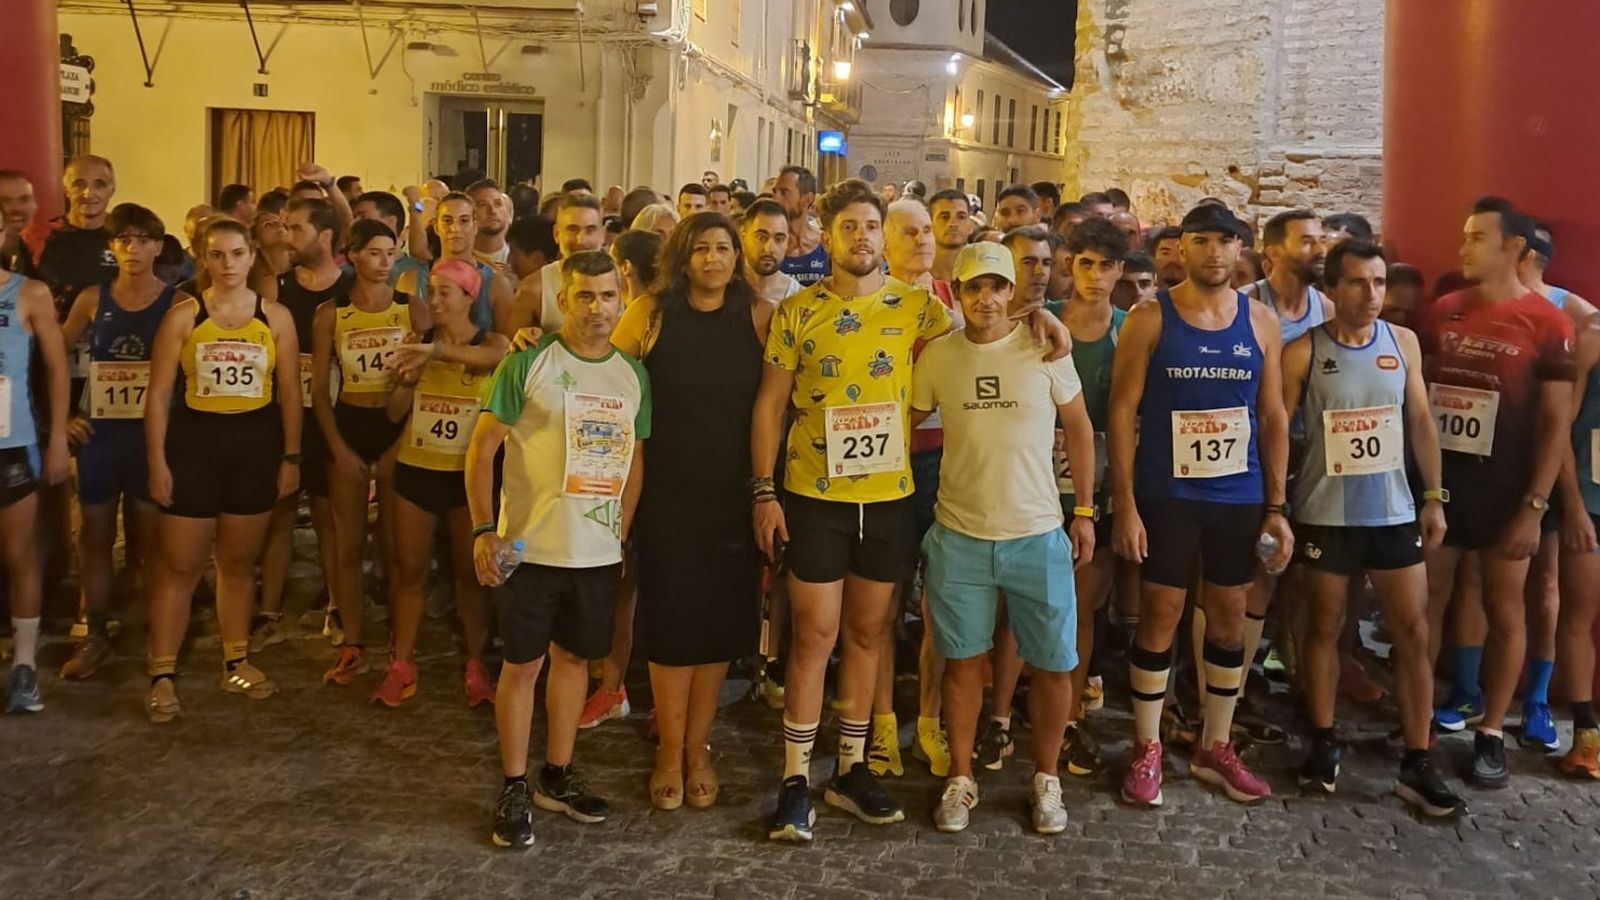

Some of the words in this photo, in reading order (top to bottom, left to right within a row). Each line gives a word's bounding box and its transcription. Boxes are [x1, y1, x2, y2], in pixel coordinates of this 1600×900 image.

[60, 70, 80, 81] LAZA
[211, 366, 253, 386] 135
[1166, 367, 1252, 380] TROTASIERRA
[105, 386, 146, 405] 117
[430, 418, 458, 440] 49
[1439, 413, 1481, 439] 100
[843, 433, 889, 459] 237
[1190, 438, 1236, 462] 137
[1350, 436, 1381, 459] 30
